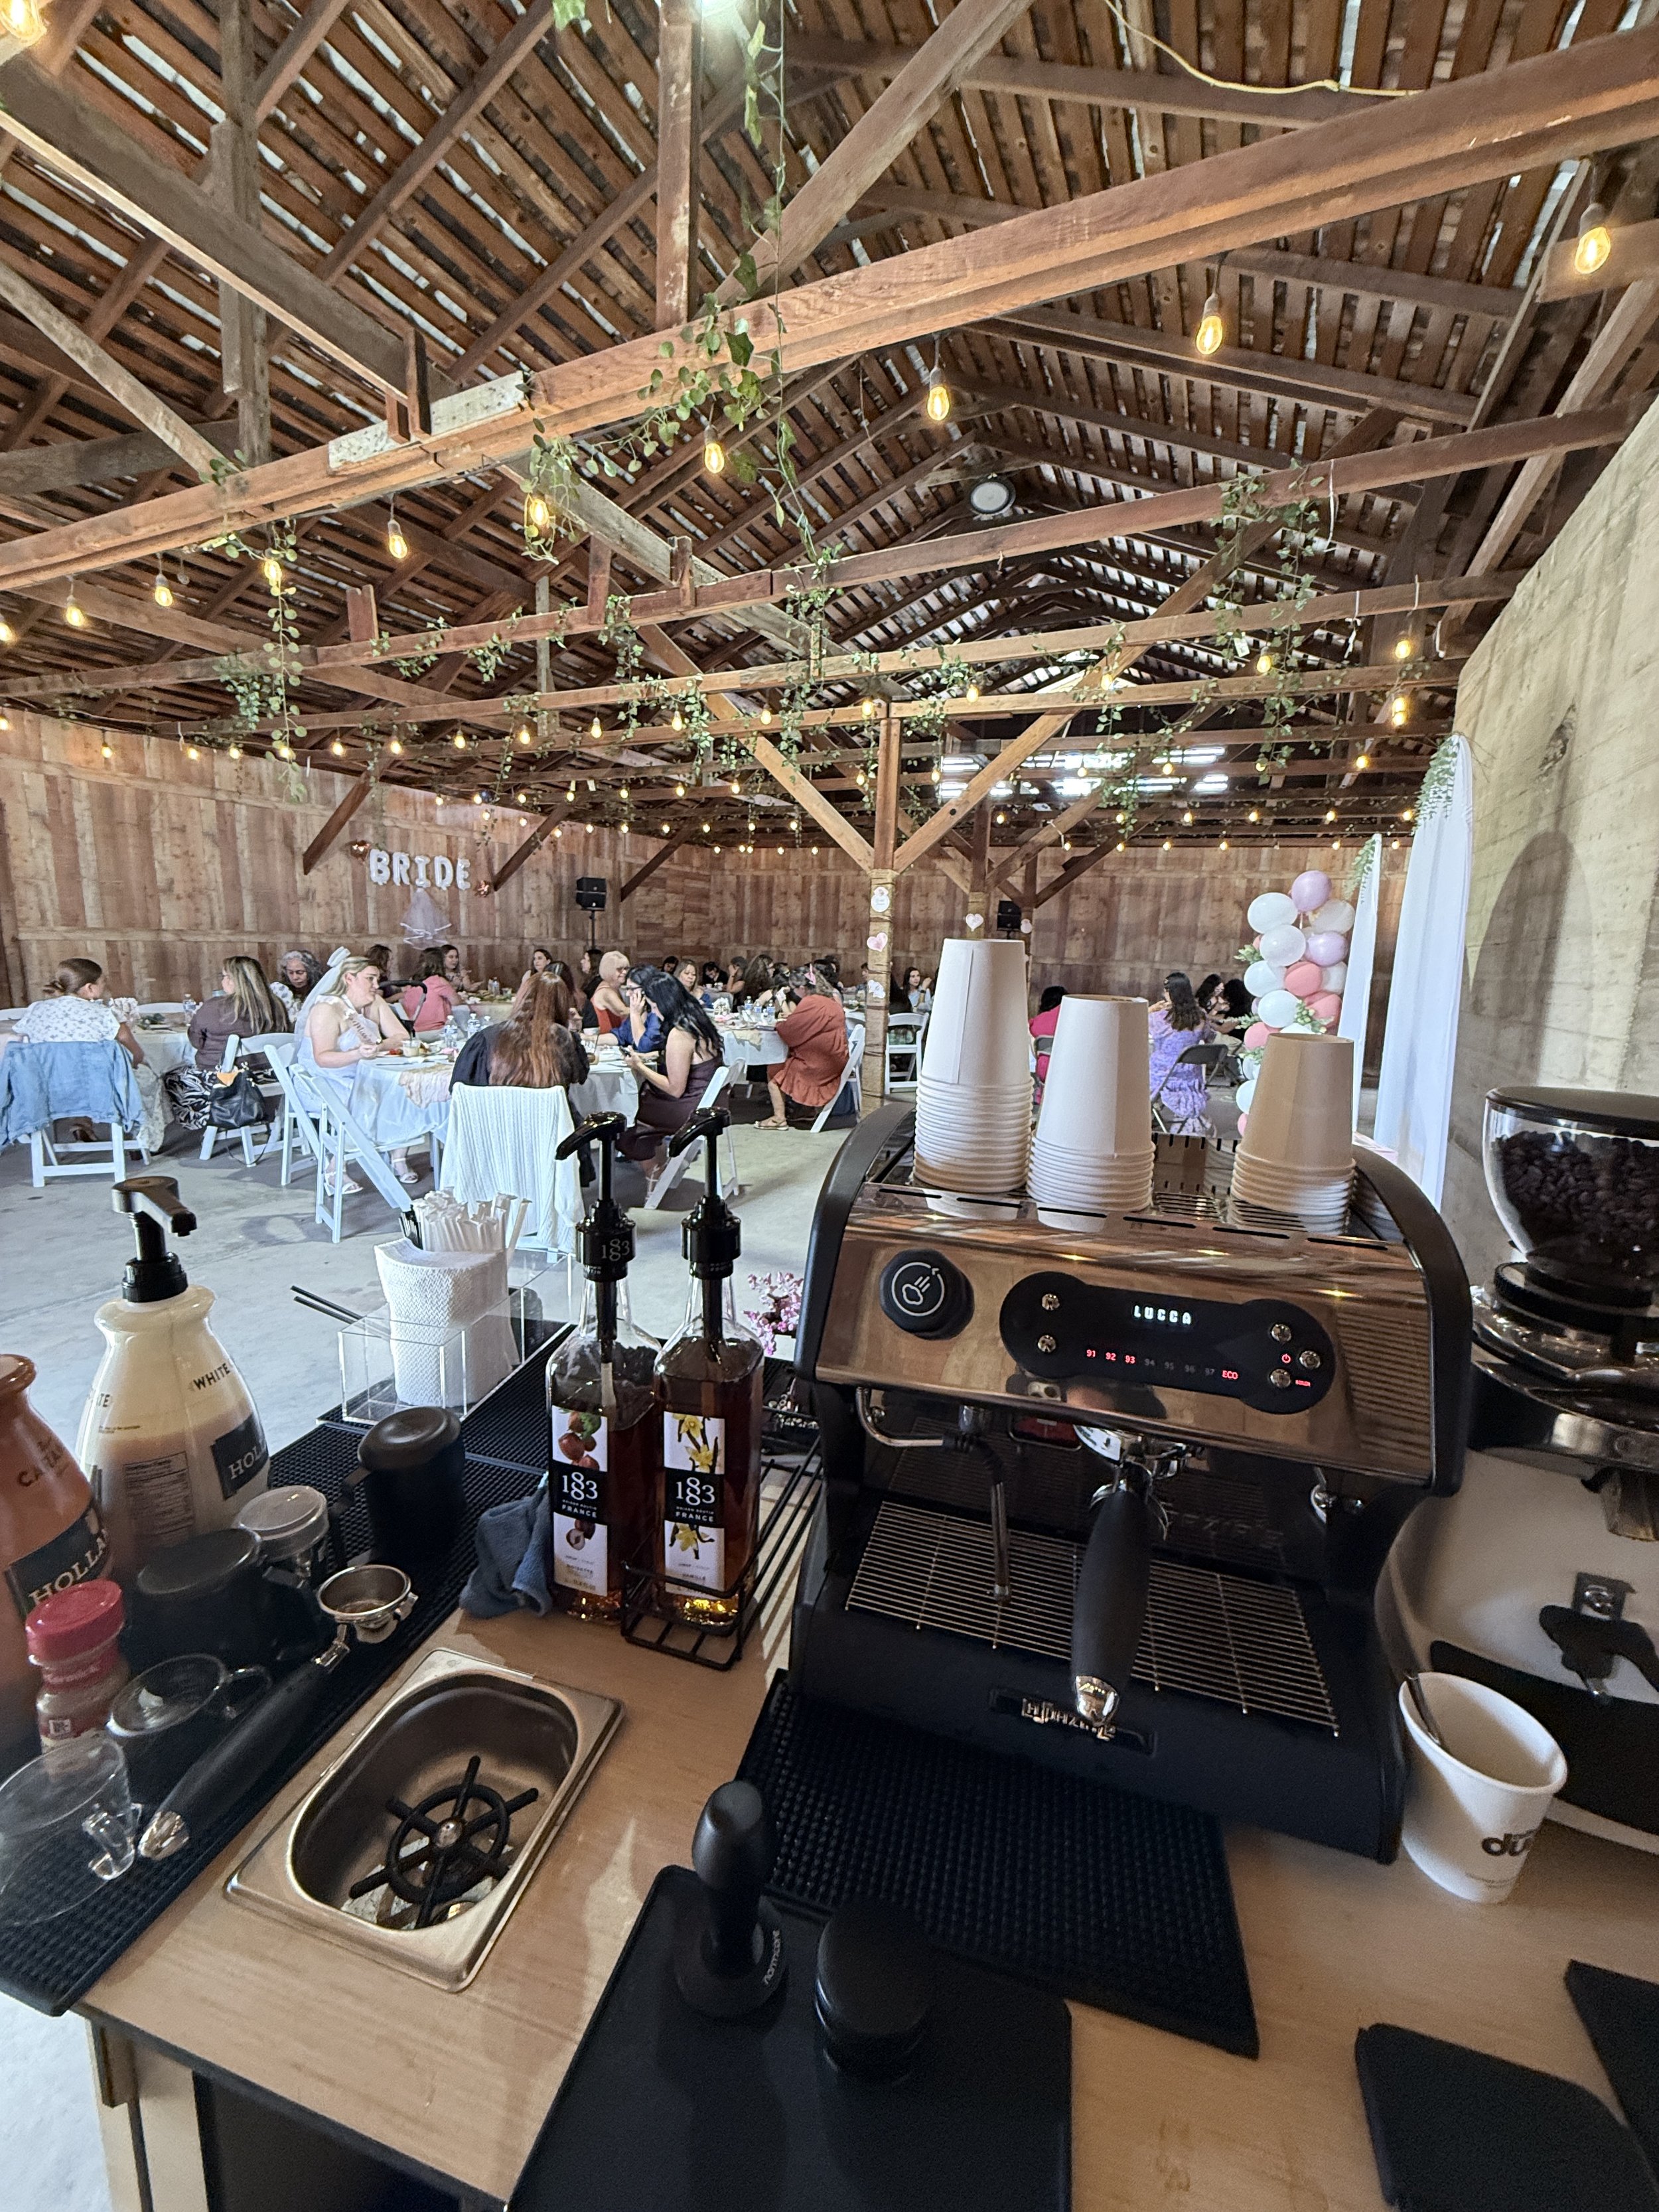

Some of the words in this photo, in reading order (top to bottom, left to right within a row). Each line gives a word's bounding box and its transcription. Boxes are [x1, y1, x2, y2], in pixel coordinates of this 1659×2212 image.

[370, 848, 471, 891] BRIDE
[1133, 1305, 1192, 1325] LUCCA
[192, 1362, 231, 1390] WHITE
[1105, 1352, 1116, 1361] 92
[1125, 1355, 1135, 1364] 93
[1222, 1370, 1238, 1380] ECO
[561, 1504, 597, 1518] FRANCE
[676, 1511, 715, 1522] FRANCE
